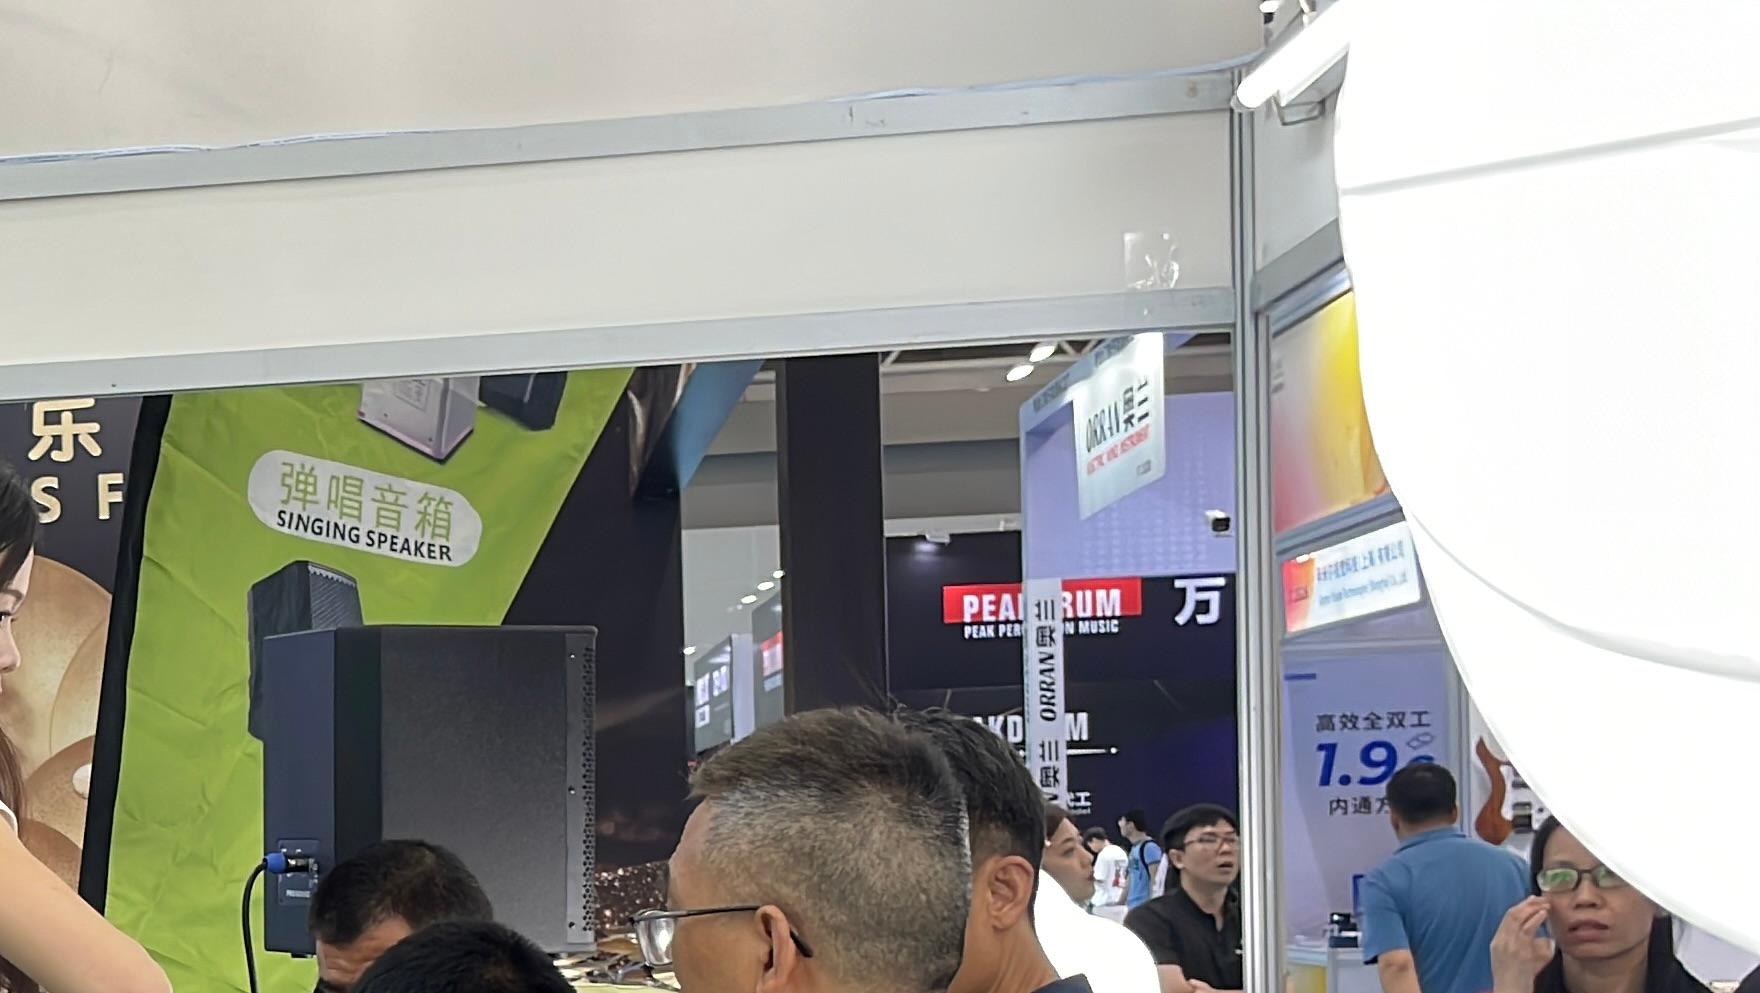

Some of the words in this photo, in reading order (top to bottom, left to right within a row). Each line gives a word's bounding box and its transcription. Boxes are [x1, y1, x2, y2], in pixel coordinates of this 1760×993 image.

[280, 461, 453, 543] 弹唱音箱
[277, 510, 361, 545] SINGING
[366, 529, 453, 562] SPEAKER
[963, 589, 1122, 623] PEARUM
[1174, 577, 1226, 626] 万
[964, 624, 995, 639] PEAK
[1078, 619, 1119, 635] MUSIC
[1039, 651, 1057, 722] ORRAN
[1316, 710, 1431, 732] 高效全双工
